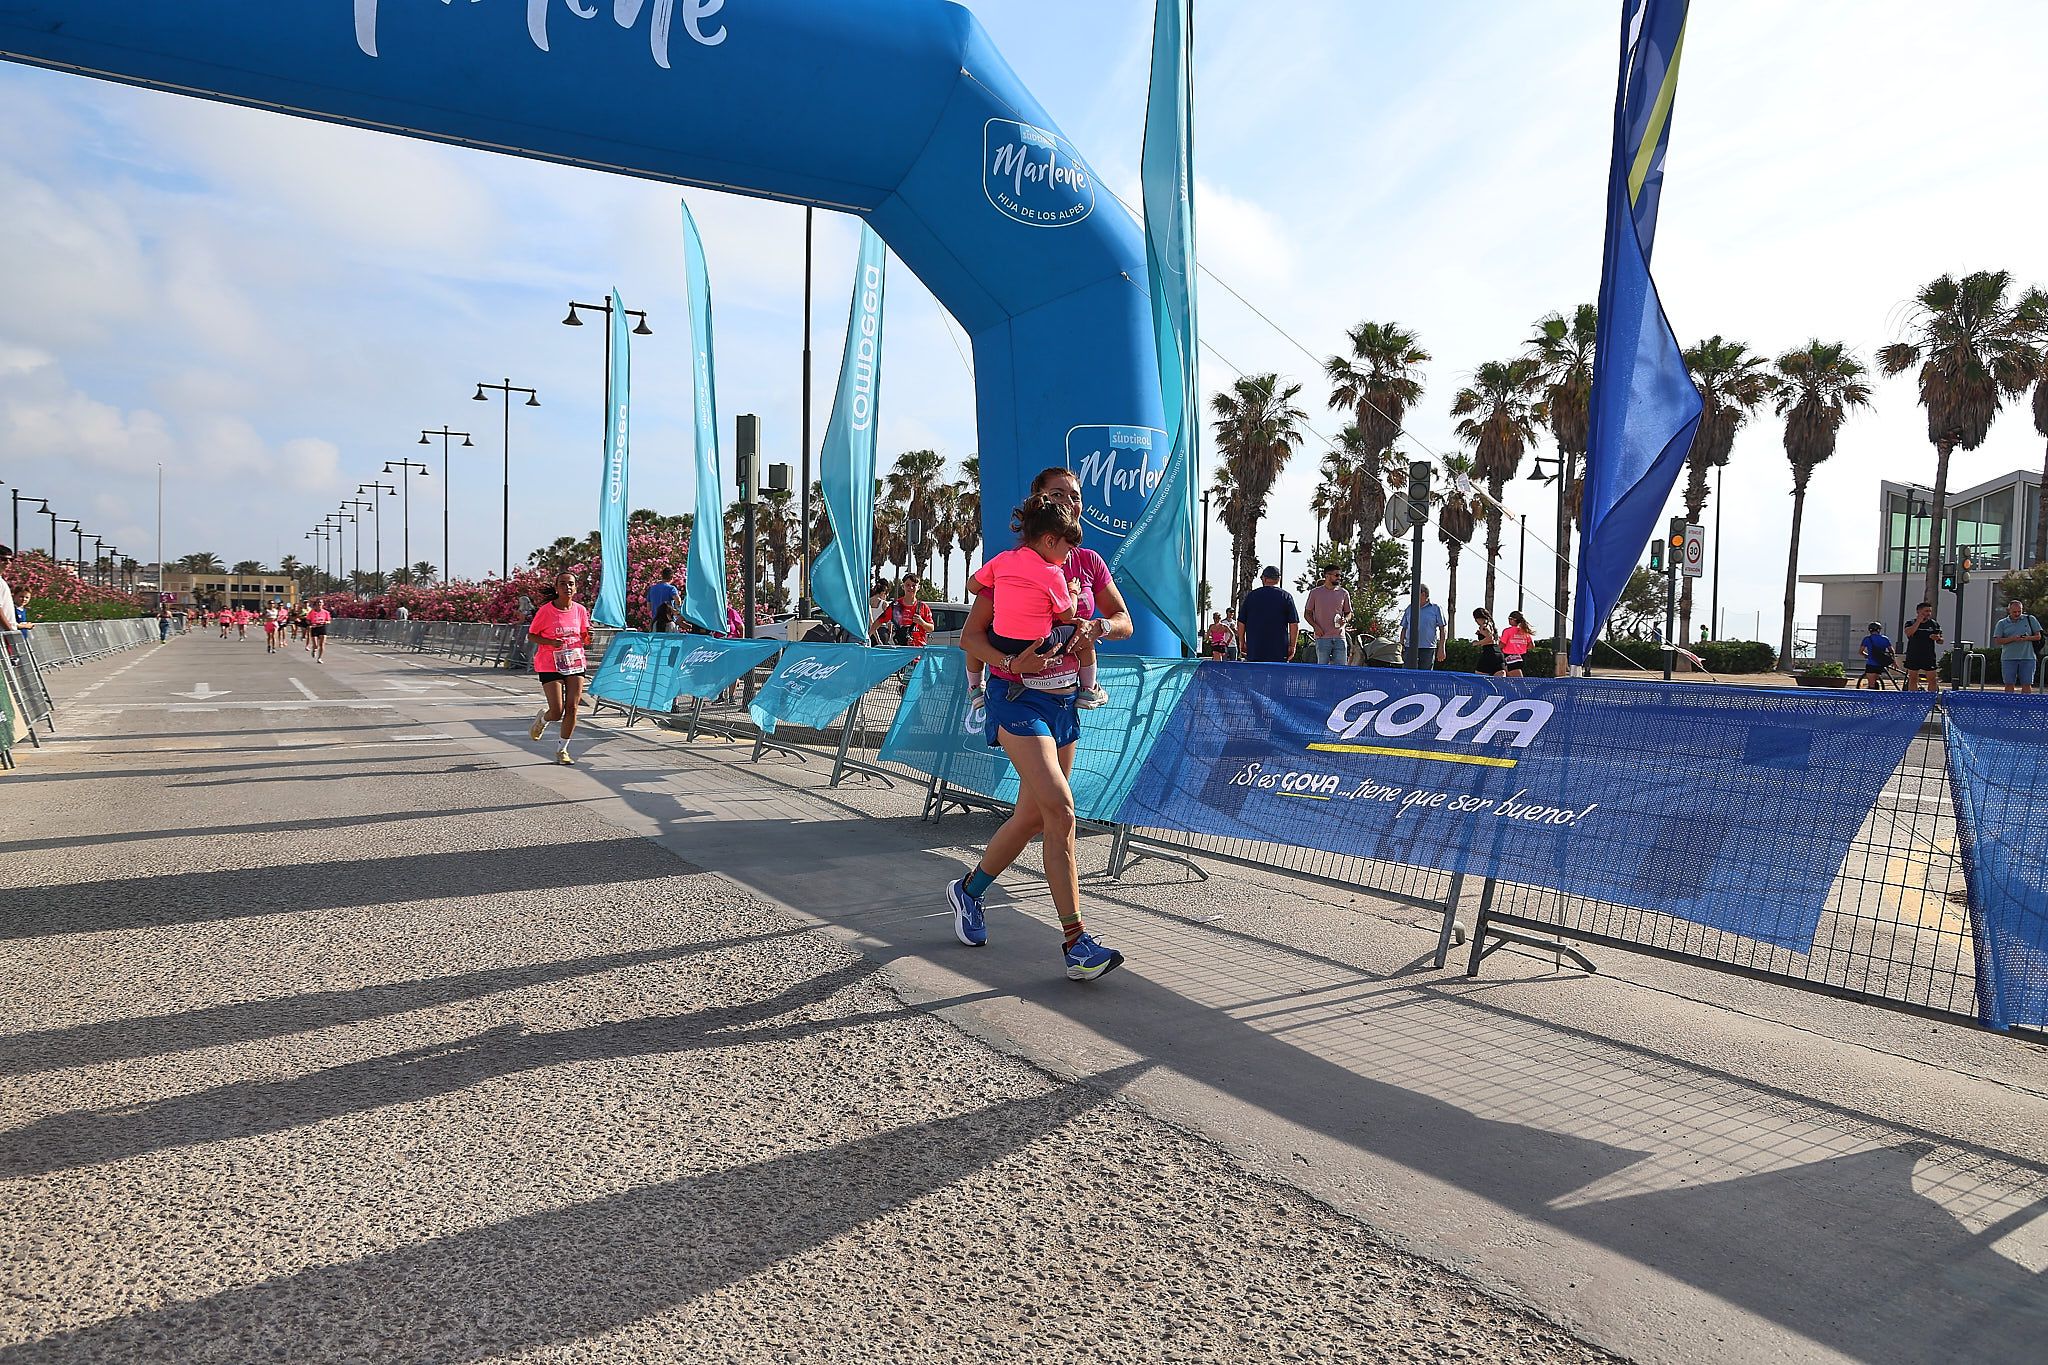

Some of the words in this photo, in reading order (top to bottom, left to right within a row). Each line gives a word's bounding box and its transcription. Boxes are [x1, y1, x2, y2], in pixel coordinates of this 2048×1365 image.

[993, 143, 1086, 196] Marlene
[997, 192, 1019, 212] HIJA
[1021, 207, 1035, 219] DE
[1037, 211, 1057, 220] LOS
[1059, 202, 1085, 220] ALPES
[1087, 504, 1110, 525] HIJA
[1113, 519, 1127, 530] DE
[1689, 546, 1698, 555] 30
[1327, 689, 1554, 748] GOYA
[1258, 772, 1282, 788] es
[1396, 788, 1448, 819] que
[1448, 794, 1494, 813] ser
[1493, 788, 1599, 827] bueno!
